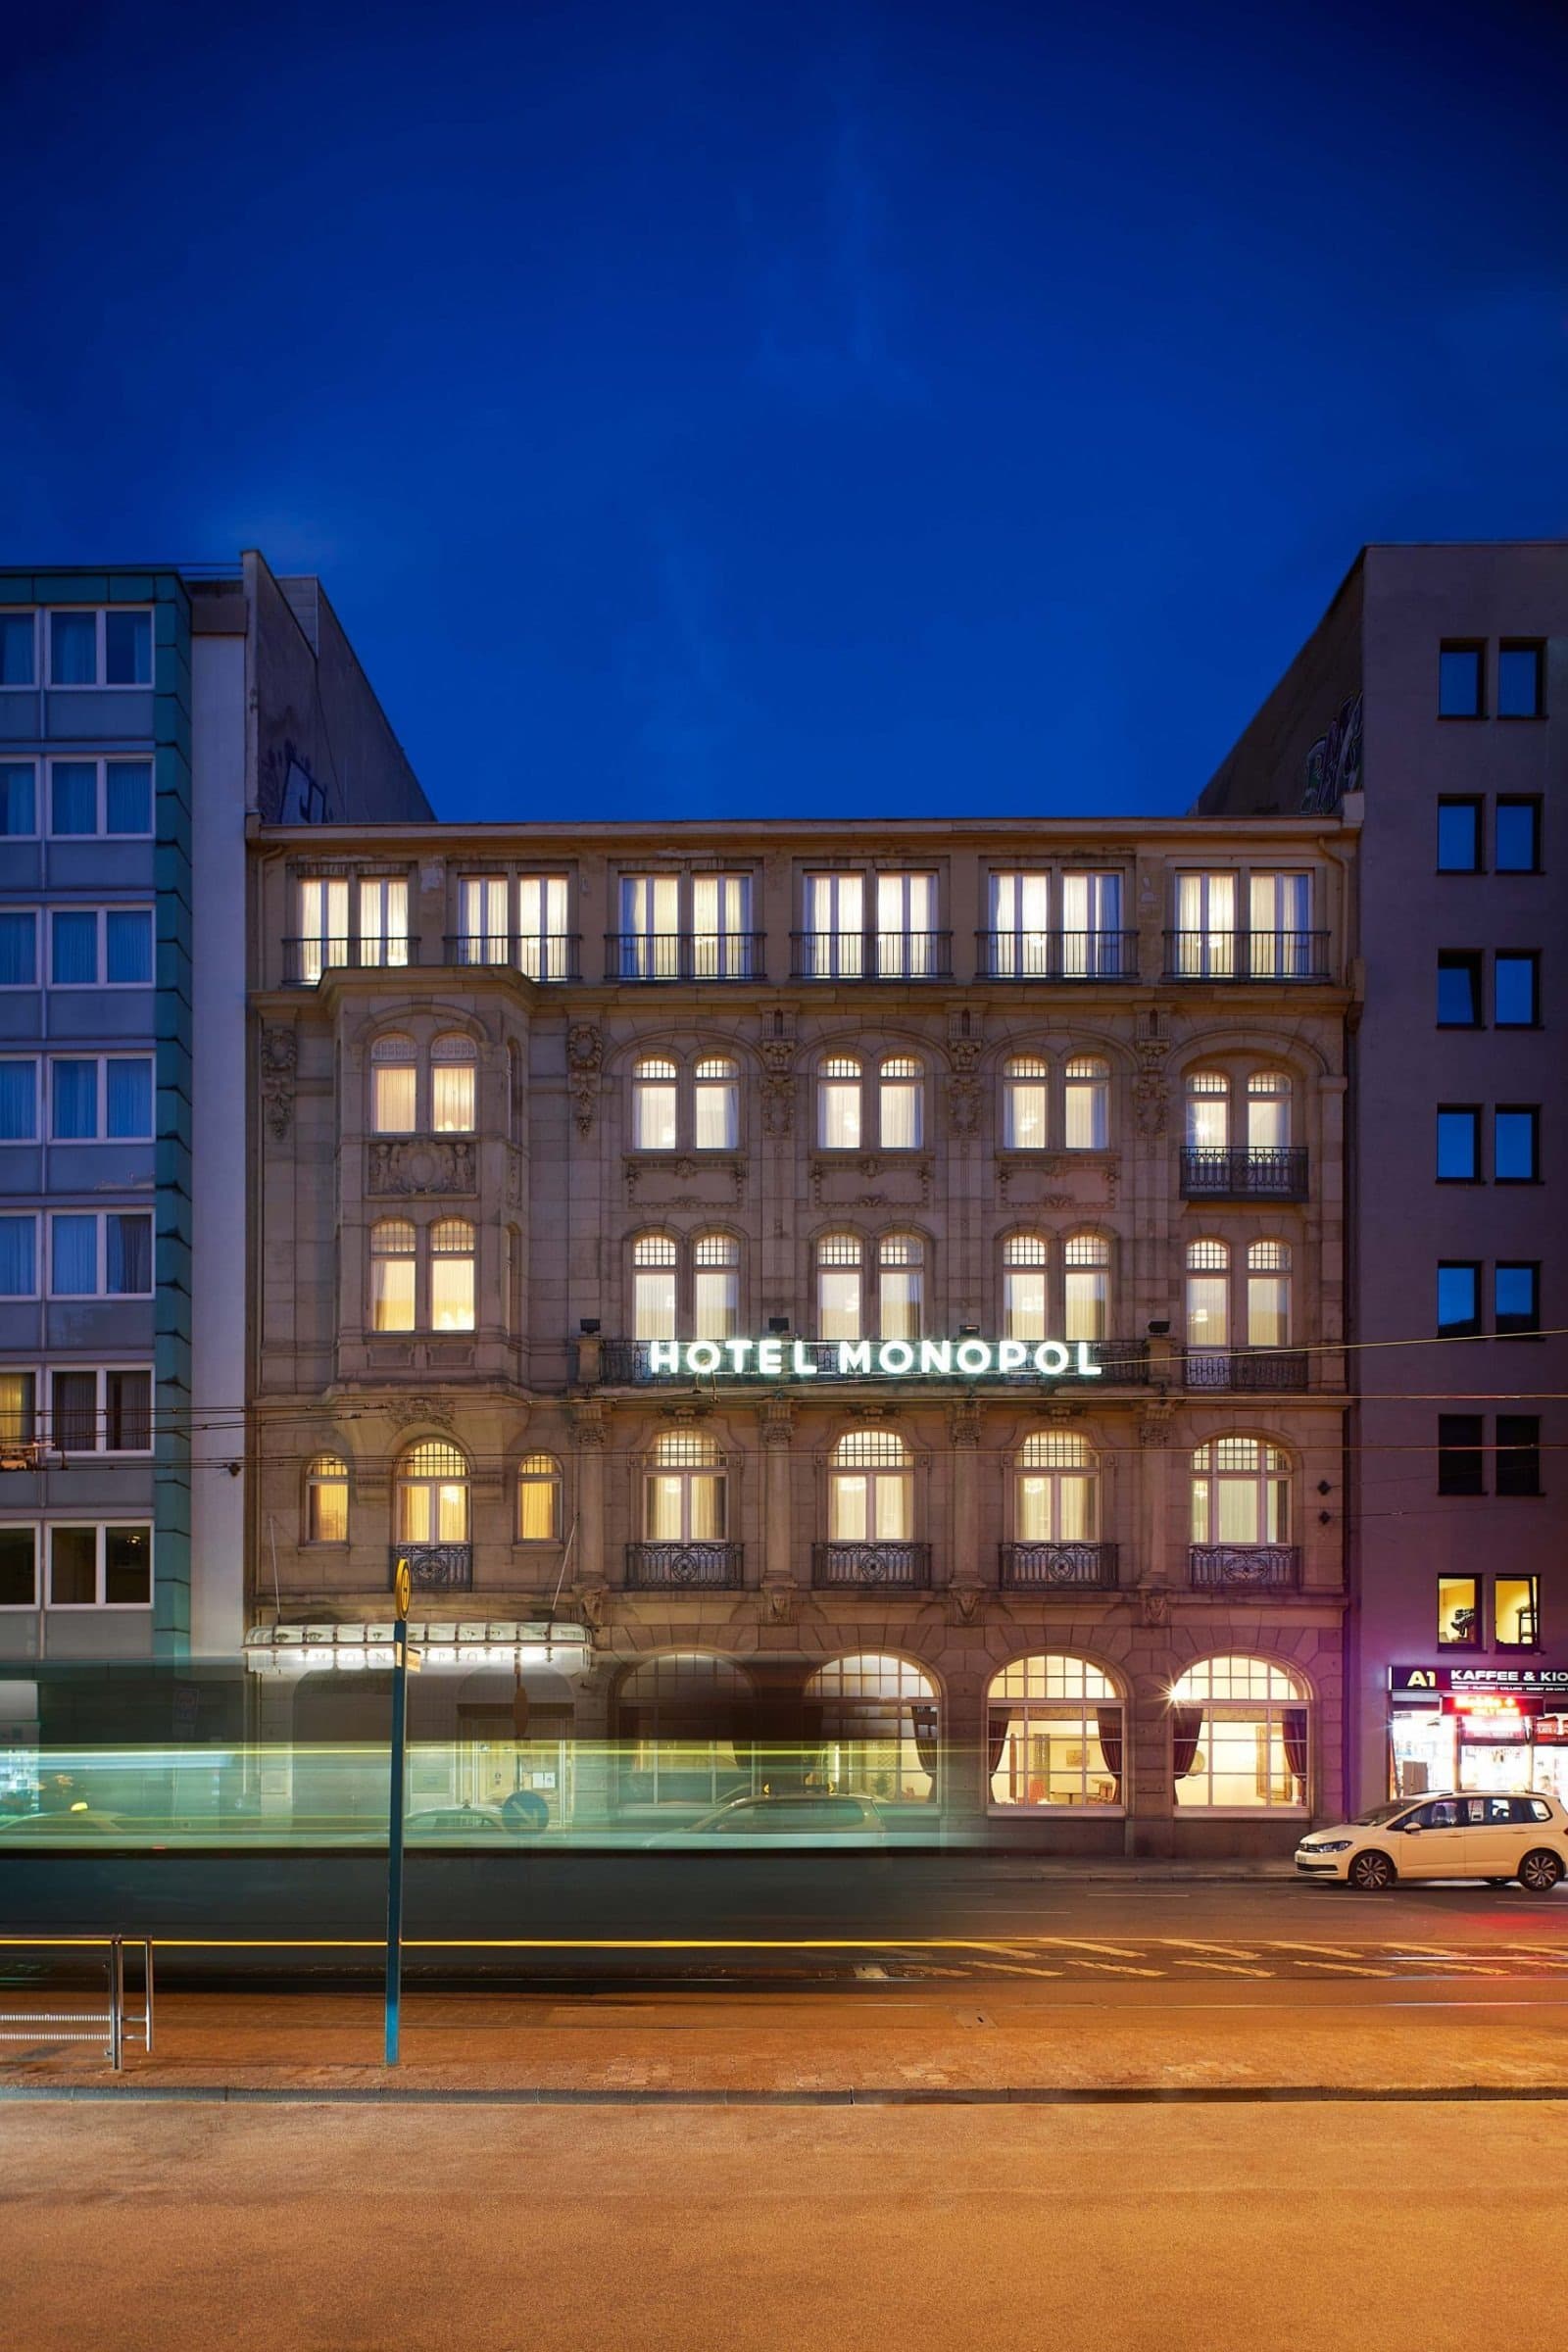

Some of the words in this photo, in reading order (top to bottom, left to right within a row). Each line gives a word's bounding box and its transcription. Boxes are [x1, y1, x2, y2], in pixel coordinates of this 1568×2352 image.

[650, 1339, 818, 1375] HOTEL
[839, 1339, 1103, 1376] MONOPOL
[1407, 1671, 1437, 1687] A1
[1450, 1669, 1519, 1682] KAFFEE
[1523, 1671, 1536, 1682] &
[1541, 1671, 1568, 1683] KIO
